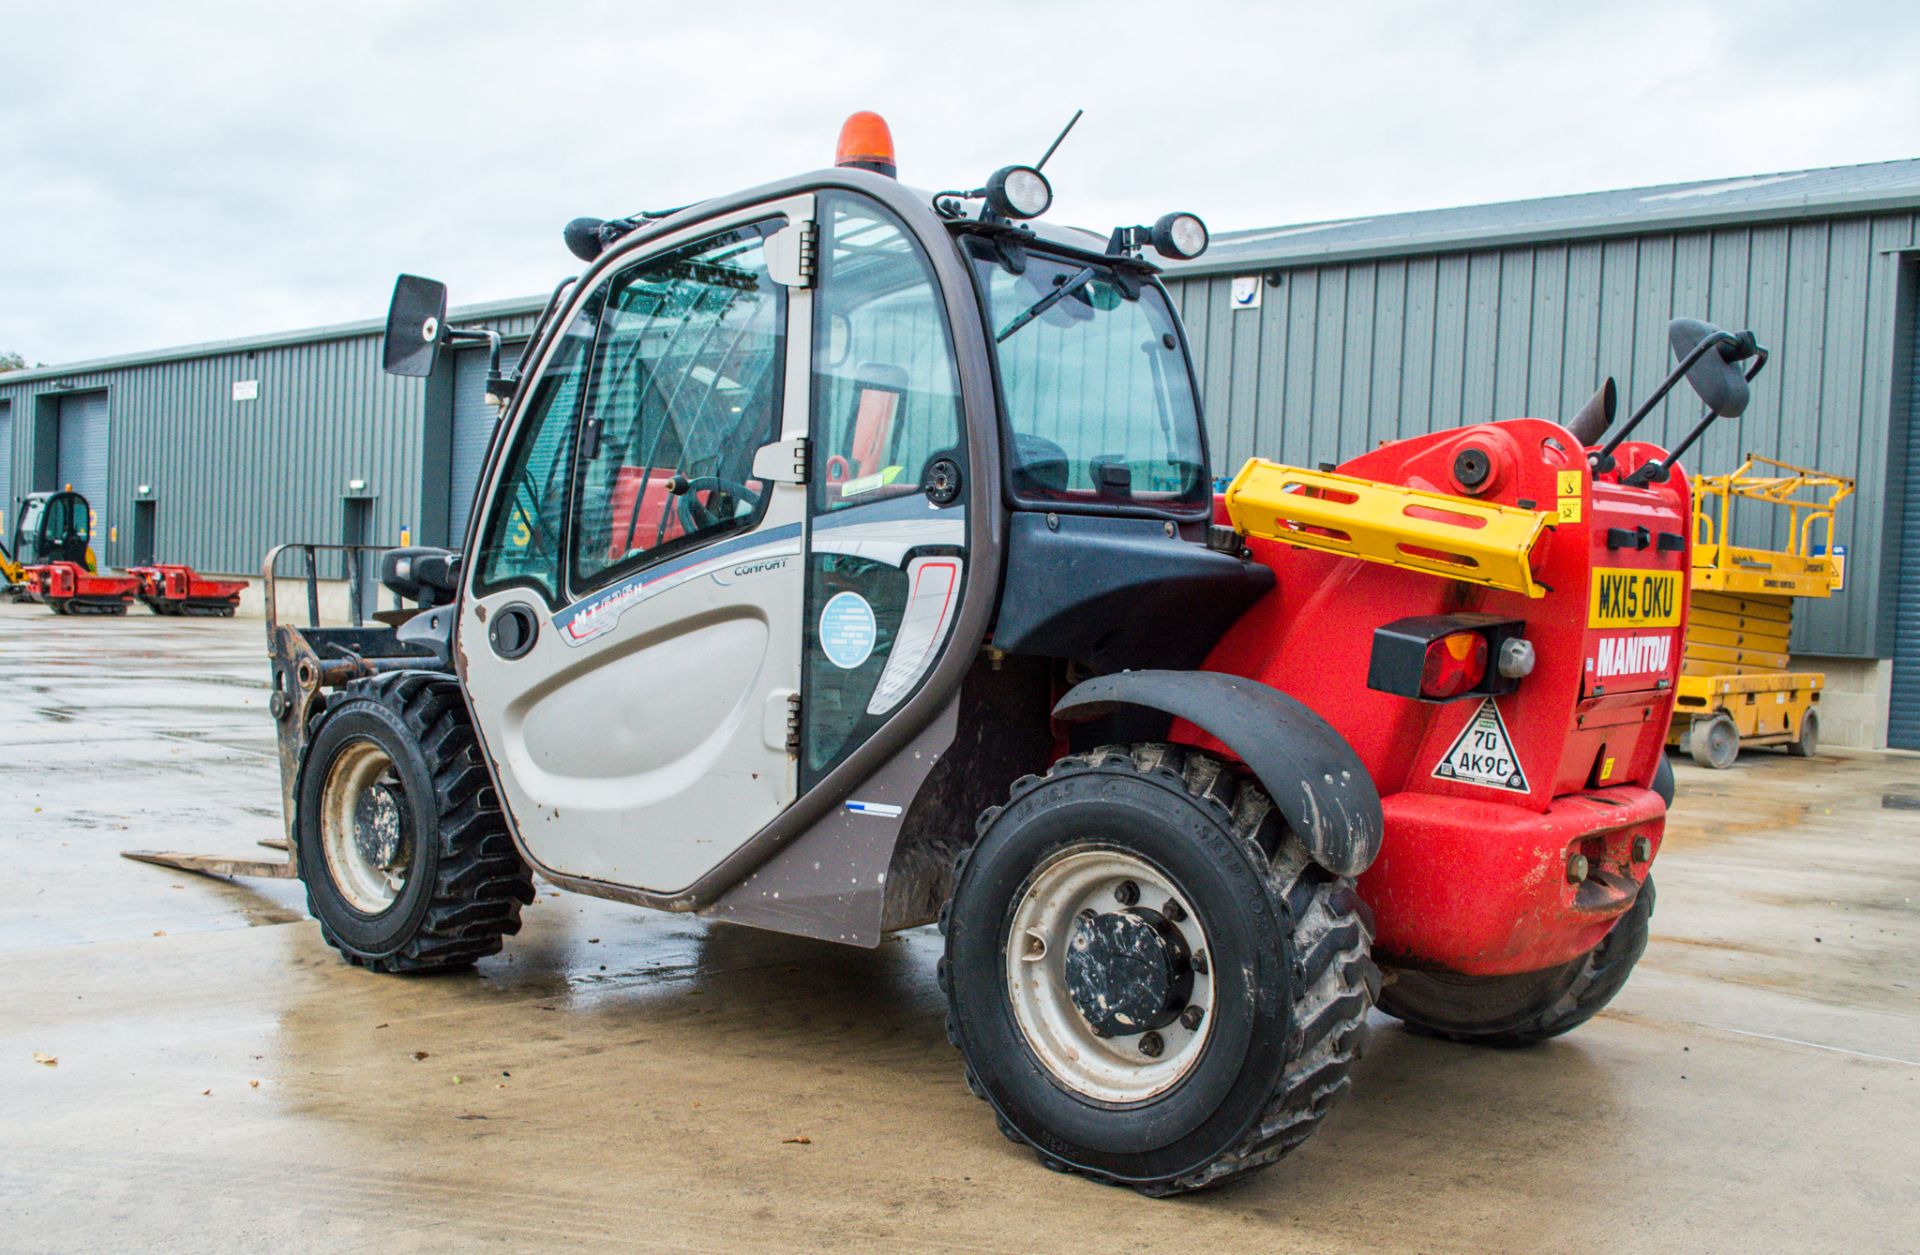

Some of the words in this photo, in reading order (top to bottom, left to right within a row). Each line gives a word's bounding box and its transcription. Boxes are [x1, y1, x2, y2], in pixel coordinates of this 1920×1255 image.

[512, 509, 531, 546] 3
[1598, 574, 1637, 619] MX15
[1642, 576, 1674, 618] OKU
[1596, 635, 1671, 677] MANITOU
[1459, 752, 1508, 777] AK9C
